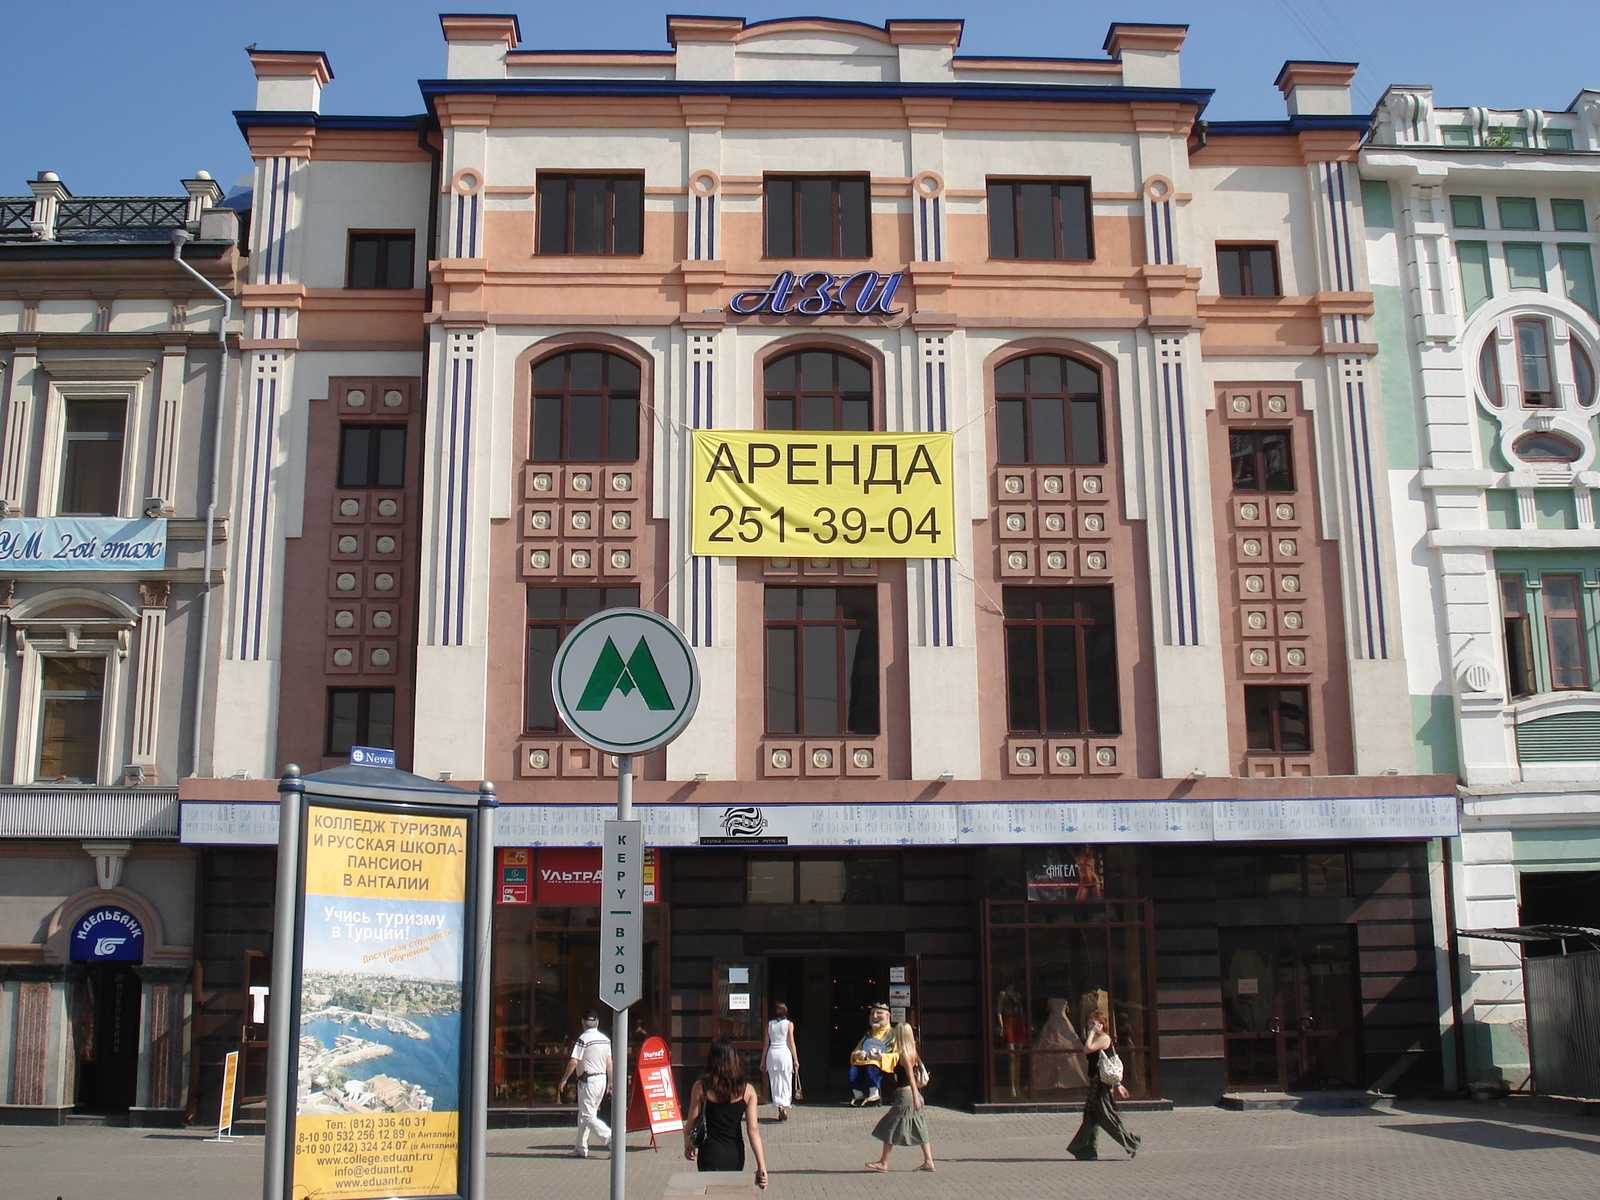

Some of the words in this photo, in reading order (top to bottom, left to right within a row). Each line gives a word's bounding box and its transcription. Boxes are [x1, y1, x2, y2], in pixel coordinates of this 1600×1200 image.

[729, 270, 904, 315] АЗИ
[705, 442, 942, 494] АРЕНДА
[708, 505, 941, 544] 251-39-04
[100, 540, 162, 559] этаж
[366, 752, 394, 764] News
[314, 814, 385, 834] КОЛЛЕДЖ
[390, 821, 463, 838] ТУРИЗМА
[314, 834, 323, 847] И
[328, 834, 394, 852] РУССКАЯ
[400, 841, 464, 857] ШКОЛА-
[347, 856, 422, 872] ПАНСИОН
[344, 874, 352, 886] В
[356, 874, 430, 891] АНТАЛИИ
[76, 911, 143, 940] ИДЕЛЬБАНК
[324, 906, 371, 924] Учись
[376, 912, 446, 930] туризму
[332, 928, 341, 938] в
[346, 924, 410, 942] Турции!
[362, 943, 408, 964] Доступная
[408, 930, 454, 952] стоимость
[388, 946, 430, 964] обучения
[326, 1120, 346, 1130] Тел:
[350, 1118, 375, 1130] (812)
[378, 1118, 396, 1128] 336
[398, 1118, 411, 1127] 40
[415, 1117, 426, 1127] 31
[299, 1132, 320, 1142] 8-10
[322, 1132, 334, 1142] 90
[336, 1131, 354, 1141] 532
[357, 1131, 375, 1140] 256
[378, 1130, 390, 1139] 12
[393, 1130, 405, 1139] 89
[408, 1131, 416, 1140] (в
[418, 1130, 456, 1140] Анталии)
[296, 1145, 317, 1155] 8-10
[318, 1144, 330, 1154] 90
[332, 1142, 358, 1154] (242)
[361, 1142, 378, 1152] 324
[381, 1142, 393, 1151] 24
[395, 1141, 408, 1151] 07
[410, 1142, 418, 1152] (в
[420, 1142, 458, 1152] Анталии)
[316, 1152, 433, 1166] www.college.eduant.ru
[334, 1165, 413, 1178] info@eduant.ru
[336, 1176, 412, 1188] www.eduant.ru
